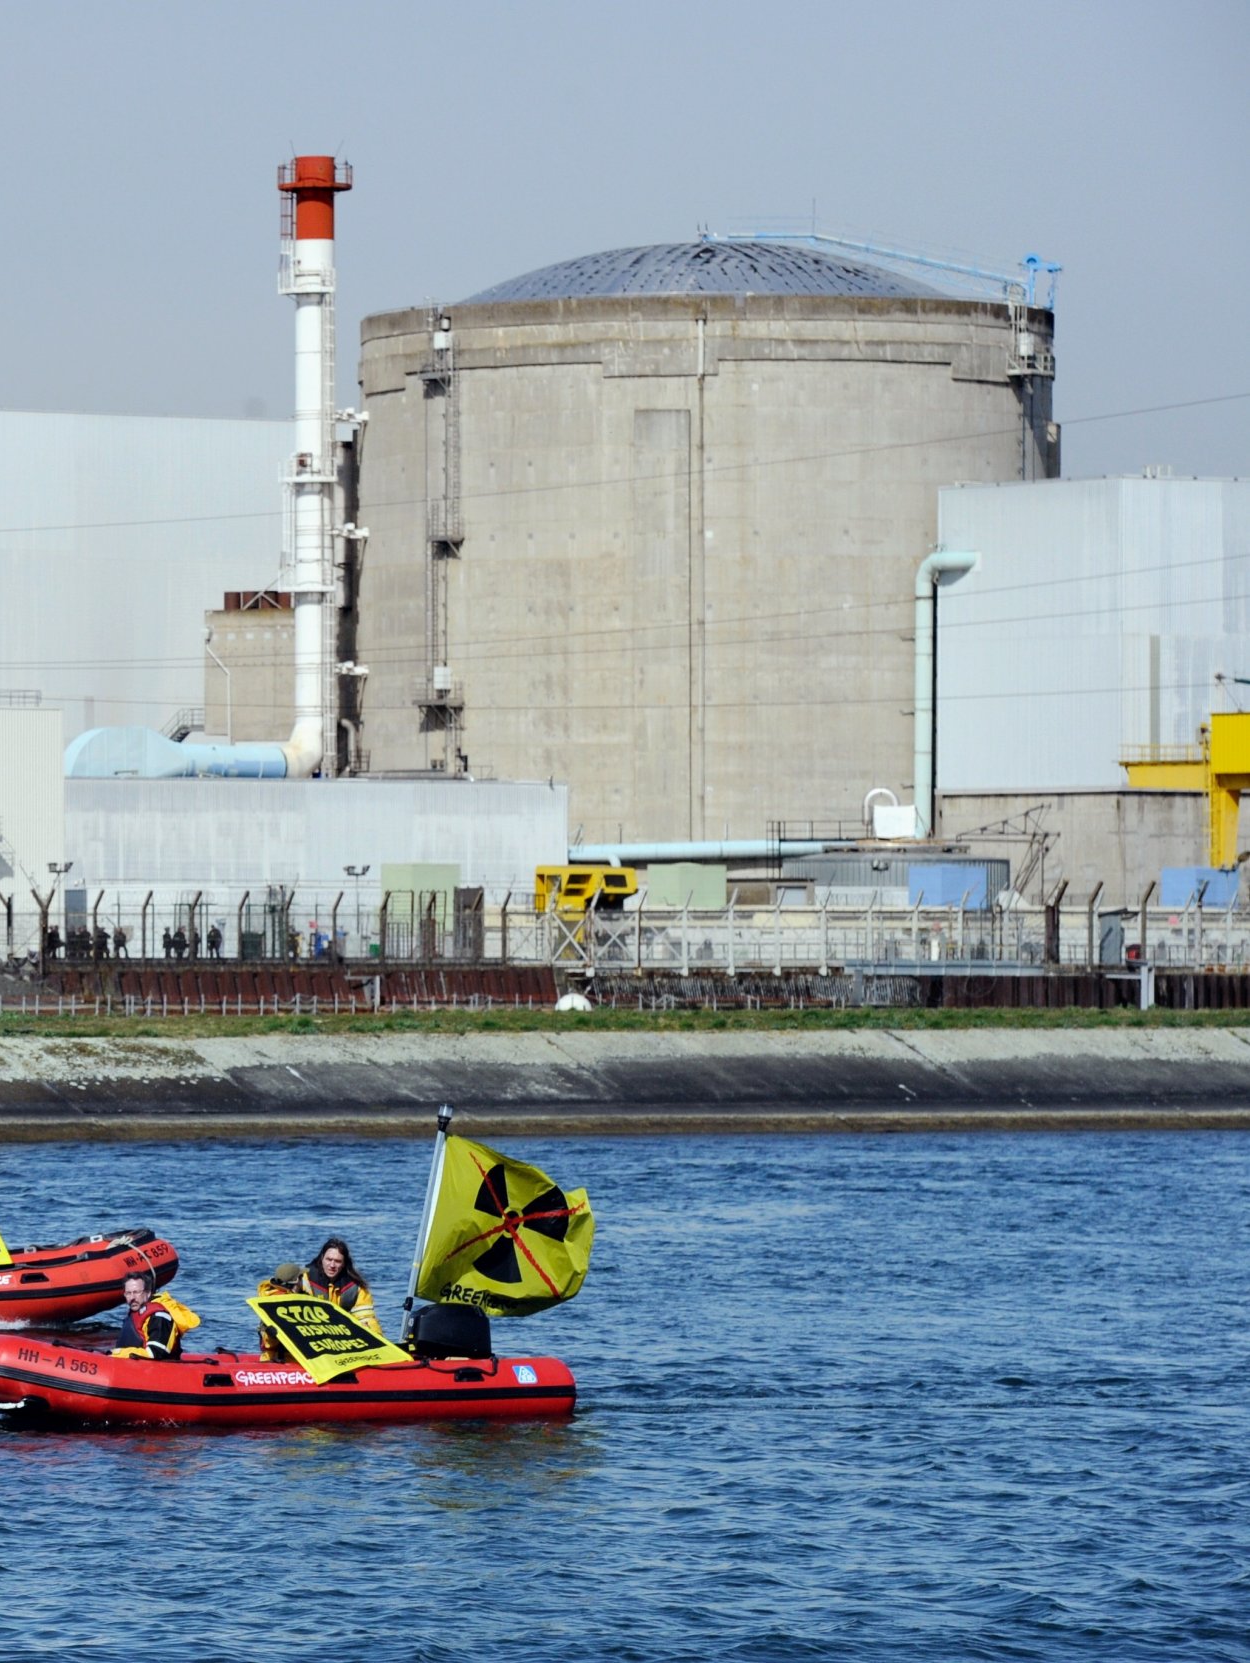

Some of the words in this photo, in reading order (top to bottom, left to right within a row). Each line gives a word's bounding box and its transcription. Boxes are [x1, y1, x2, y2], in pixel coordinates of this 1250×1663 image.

[150, 1243, 169, 1258] 859
[276, 1305, 331, 1324] STOP
[295, 1324, 351, 1337] RISKING
[309, 1338, 368, 1353] EUROPE!
[17, 1347, 40, 1363] HH
[55, 1356, 66, 1369] A
[70, 1359, 98, 1375] 563
[235, 1371, 316, 1387] GREENPEAC
